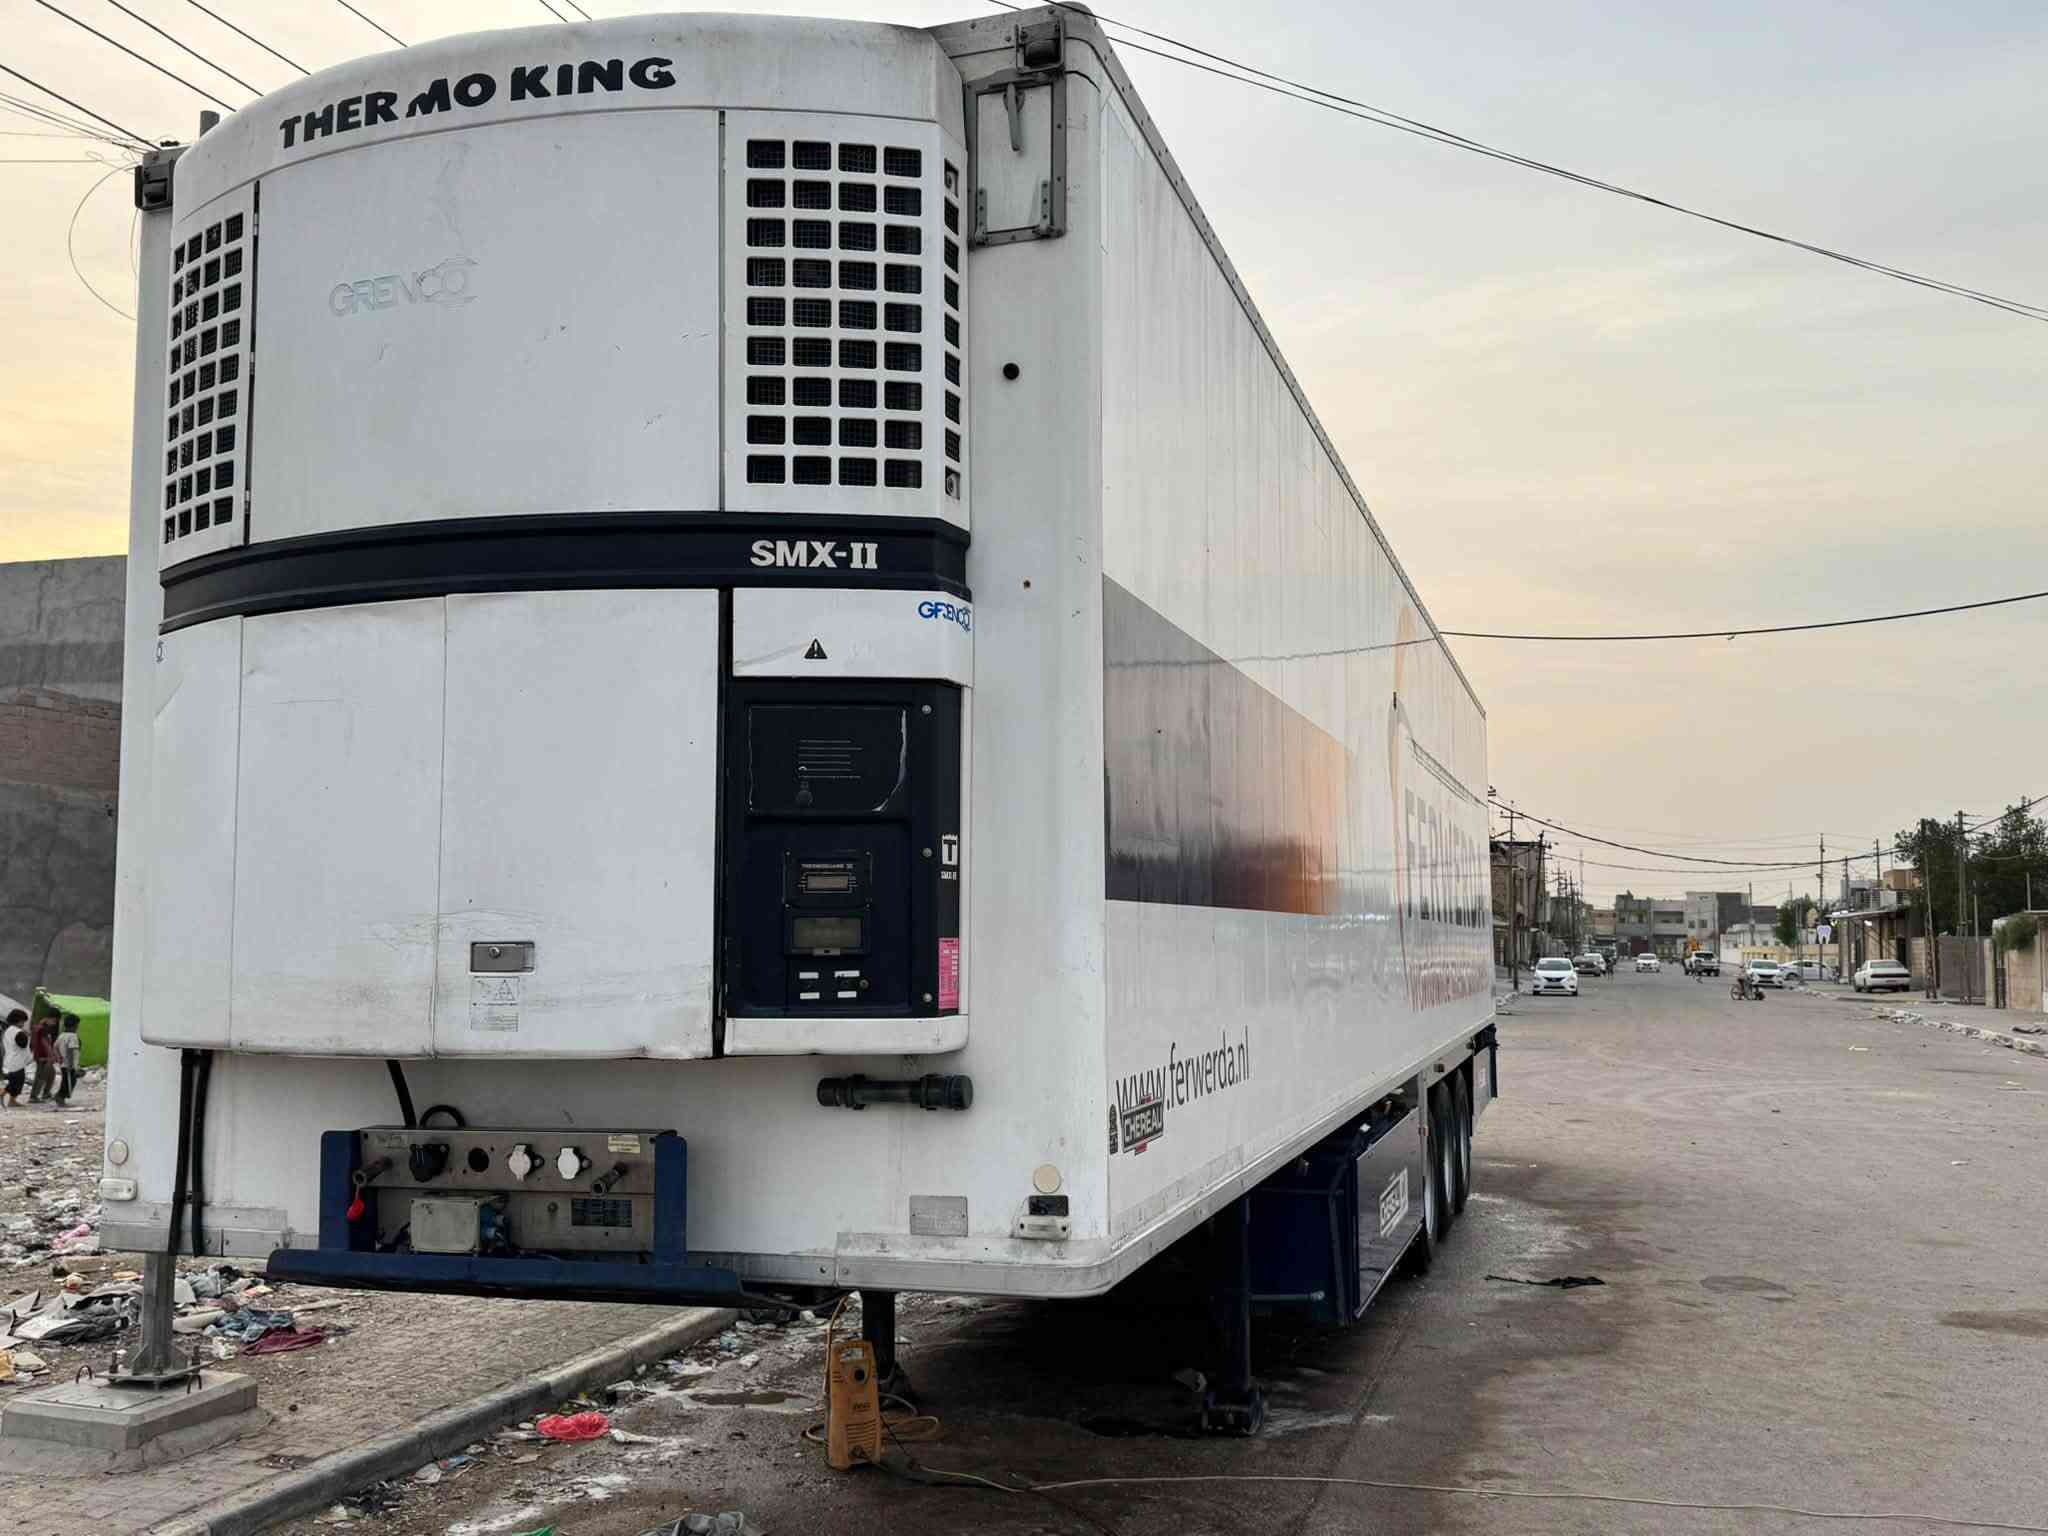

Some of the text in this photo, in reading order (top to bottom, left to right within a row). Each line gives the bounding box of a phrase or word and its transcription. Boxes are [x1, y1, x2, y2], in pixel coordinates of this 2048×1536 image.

[279, 57, 677, 149] THERMO KING
[750, 540, 878, 569] SMX-II
